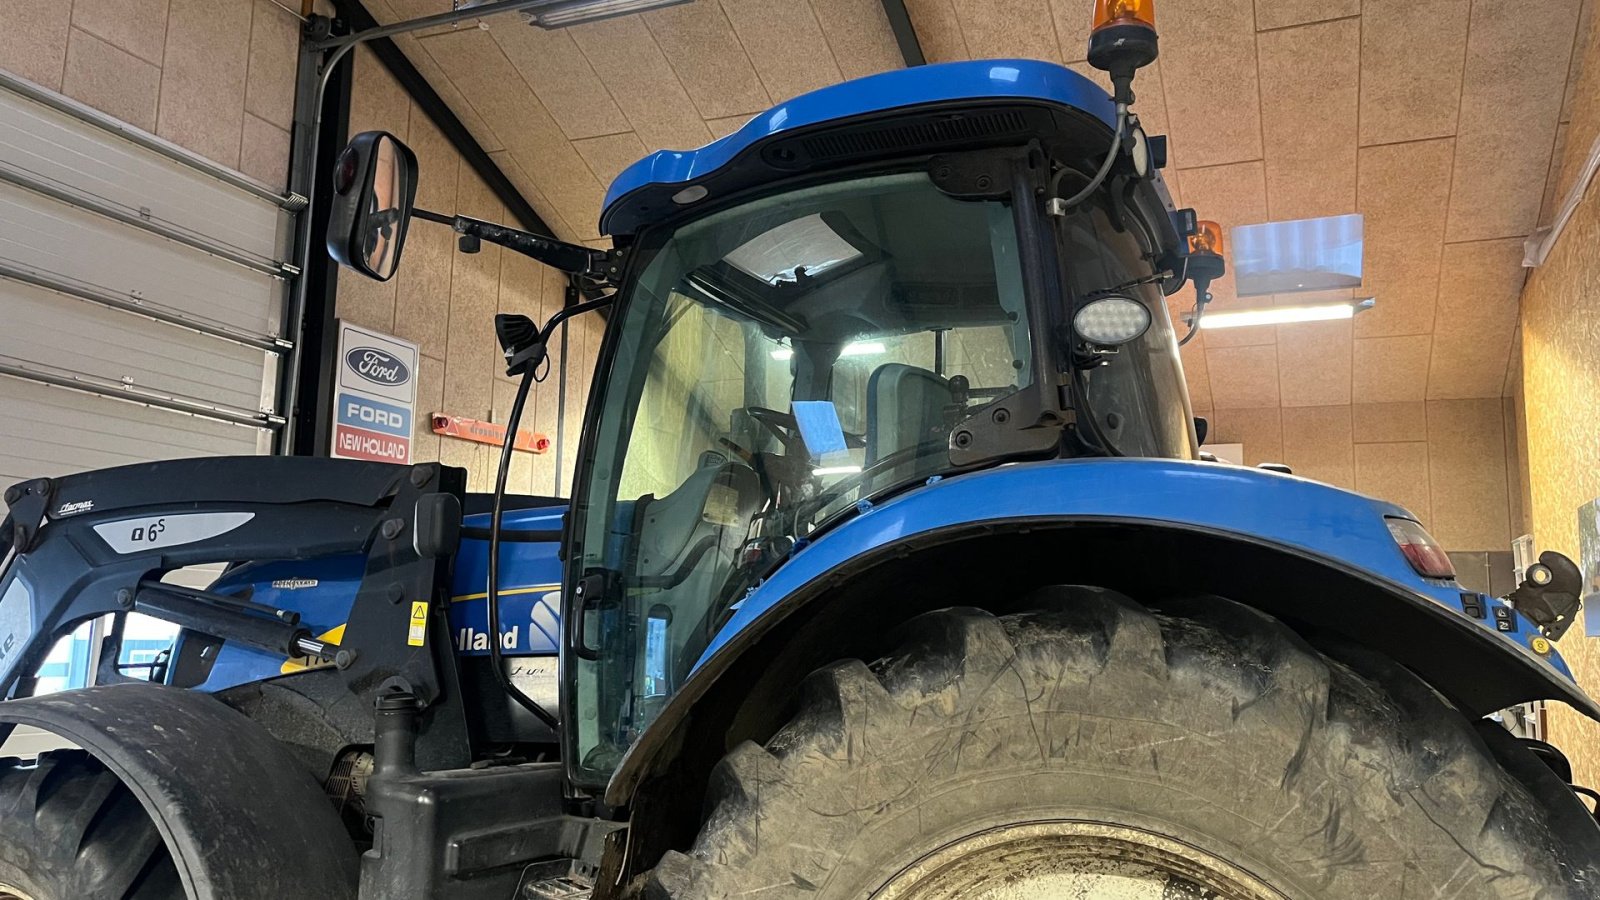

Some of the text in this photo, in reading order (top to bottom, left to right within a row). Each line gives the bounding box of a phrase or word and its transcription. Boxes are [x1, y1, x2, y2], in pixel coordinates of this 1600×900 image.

[358, 350, 398, 383] Ford
[347, 402, 402, 428] FORD
[339, 432, 405, 460] NEW HOLLAND
